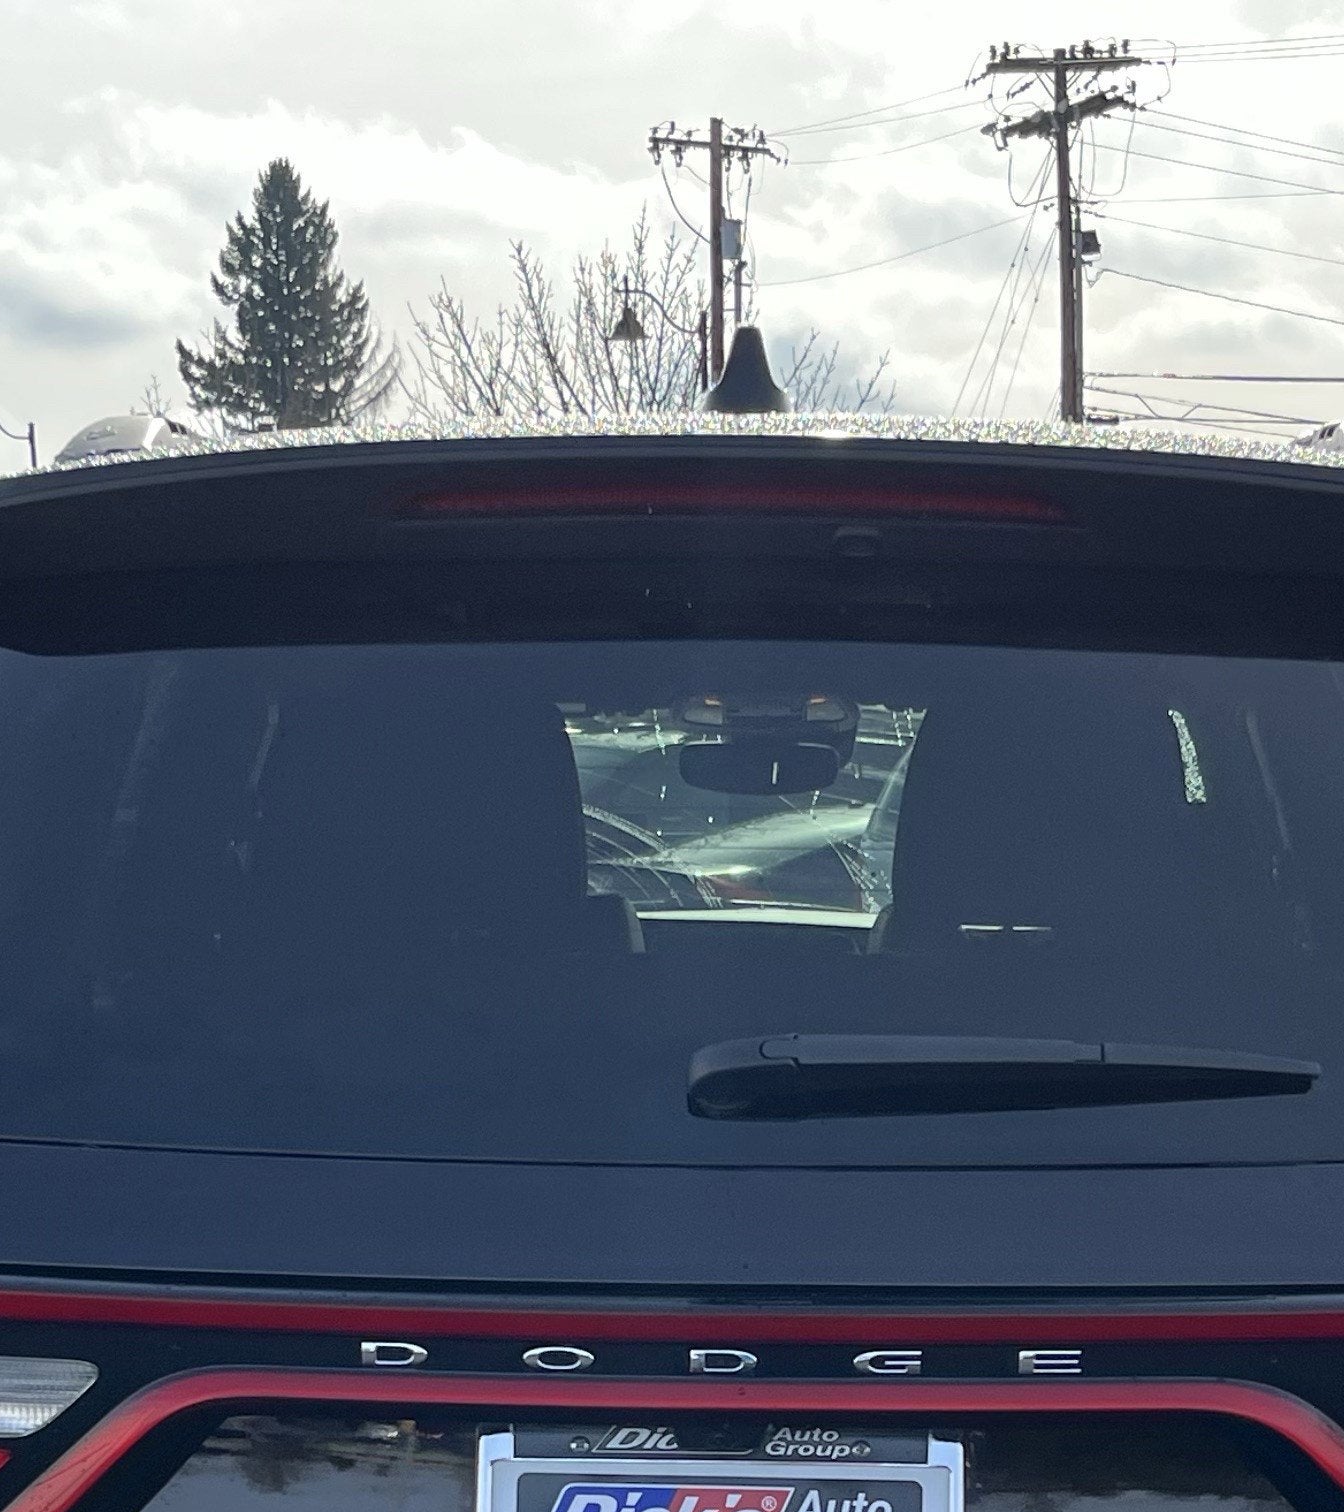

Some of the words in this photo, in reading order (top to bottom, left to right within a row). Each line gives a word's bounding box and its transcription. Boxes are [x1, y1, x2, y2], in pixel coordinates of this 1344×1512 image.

[360, 1341, 1082, 1374] DODGE
[772, 1426, 840, 1443] Auto
[764, 1440, 850, 1460] Group
